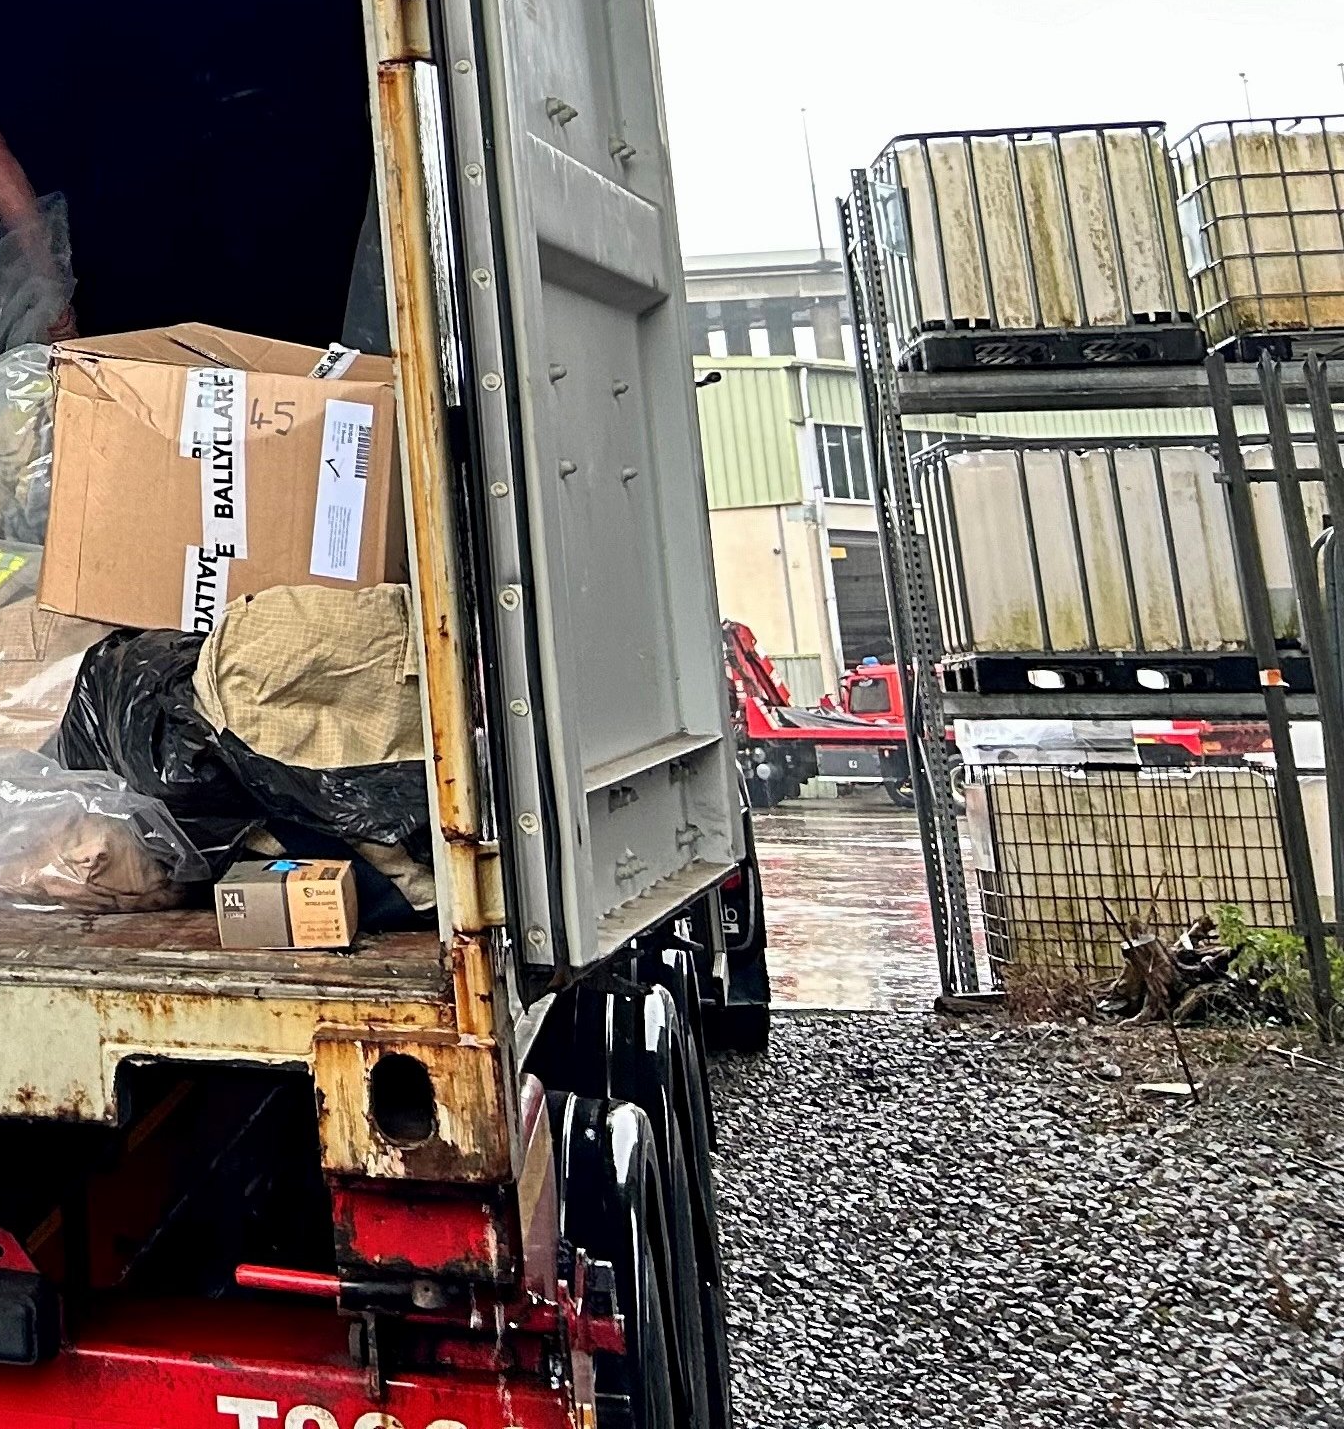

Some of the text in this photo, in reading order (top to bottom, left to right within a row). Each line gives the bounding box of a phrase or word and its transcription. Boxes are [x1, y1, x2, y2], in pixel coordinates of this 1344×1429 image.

[250, 397, 296, 436] 45
[213, 374, 234, 519] BALLYCLARE
[223, 892, 244, 907] XL
